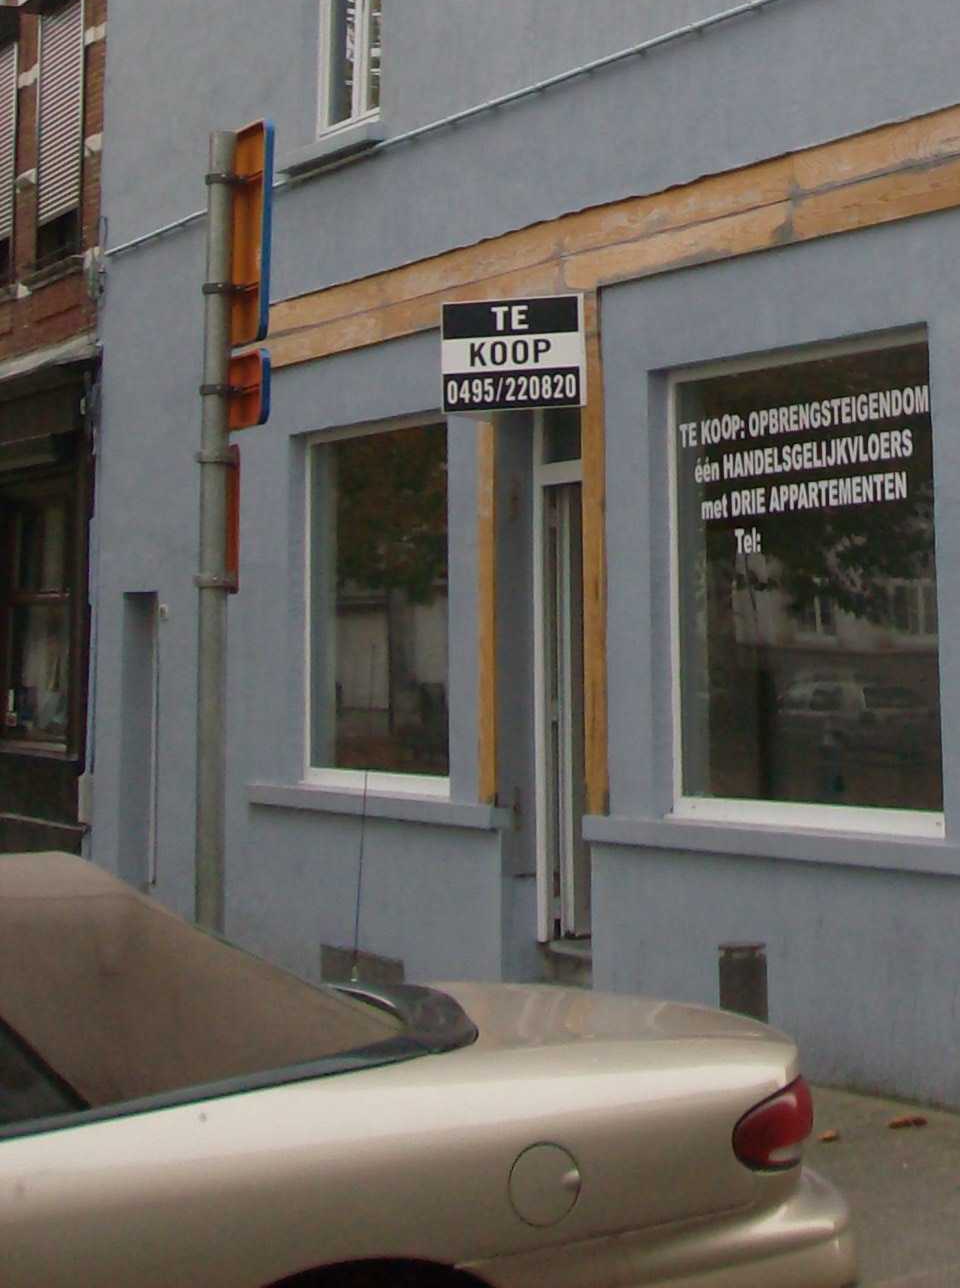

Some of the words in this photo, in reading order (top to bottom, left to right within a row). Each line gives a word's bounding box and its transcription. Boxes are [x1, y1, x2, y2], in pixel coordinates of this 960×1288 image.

[490, 305, 529, 331] TE
[469, 338, 551, 367] KOOP
[446, 374, 577, 405] 0495/220820
[679, 422, 697, 448] TE
[701, 414, 745, 444] KOOP:
[748, 384, 929, 438] OPBRENGSTEIGENDOM
[694, 456, 720, 483] één
[723, 429, 913, 479] HANDELSGELIJKVLOERS
[701, 497, 728, 520] met
[731, 487, 766, 516] DRIE
[769, 471, 907, 513] APPARTEMENTEN
[735, 527, 762, 554] Tel:
